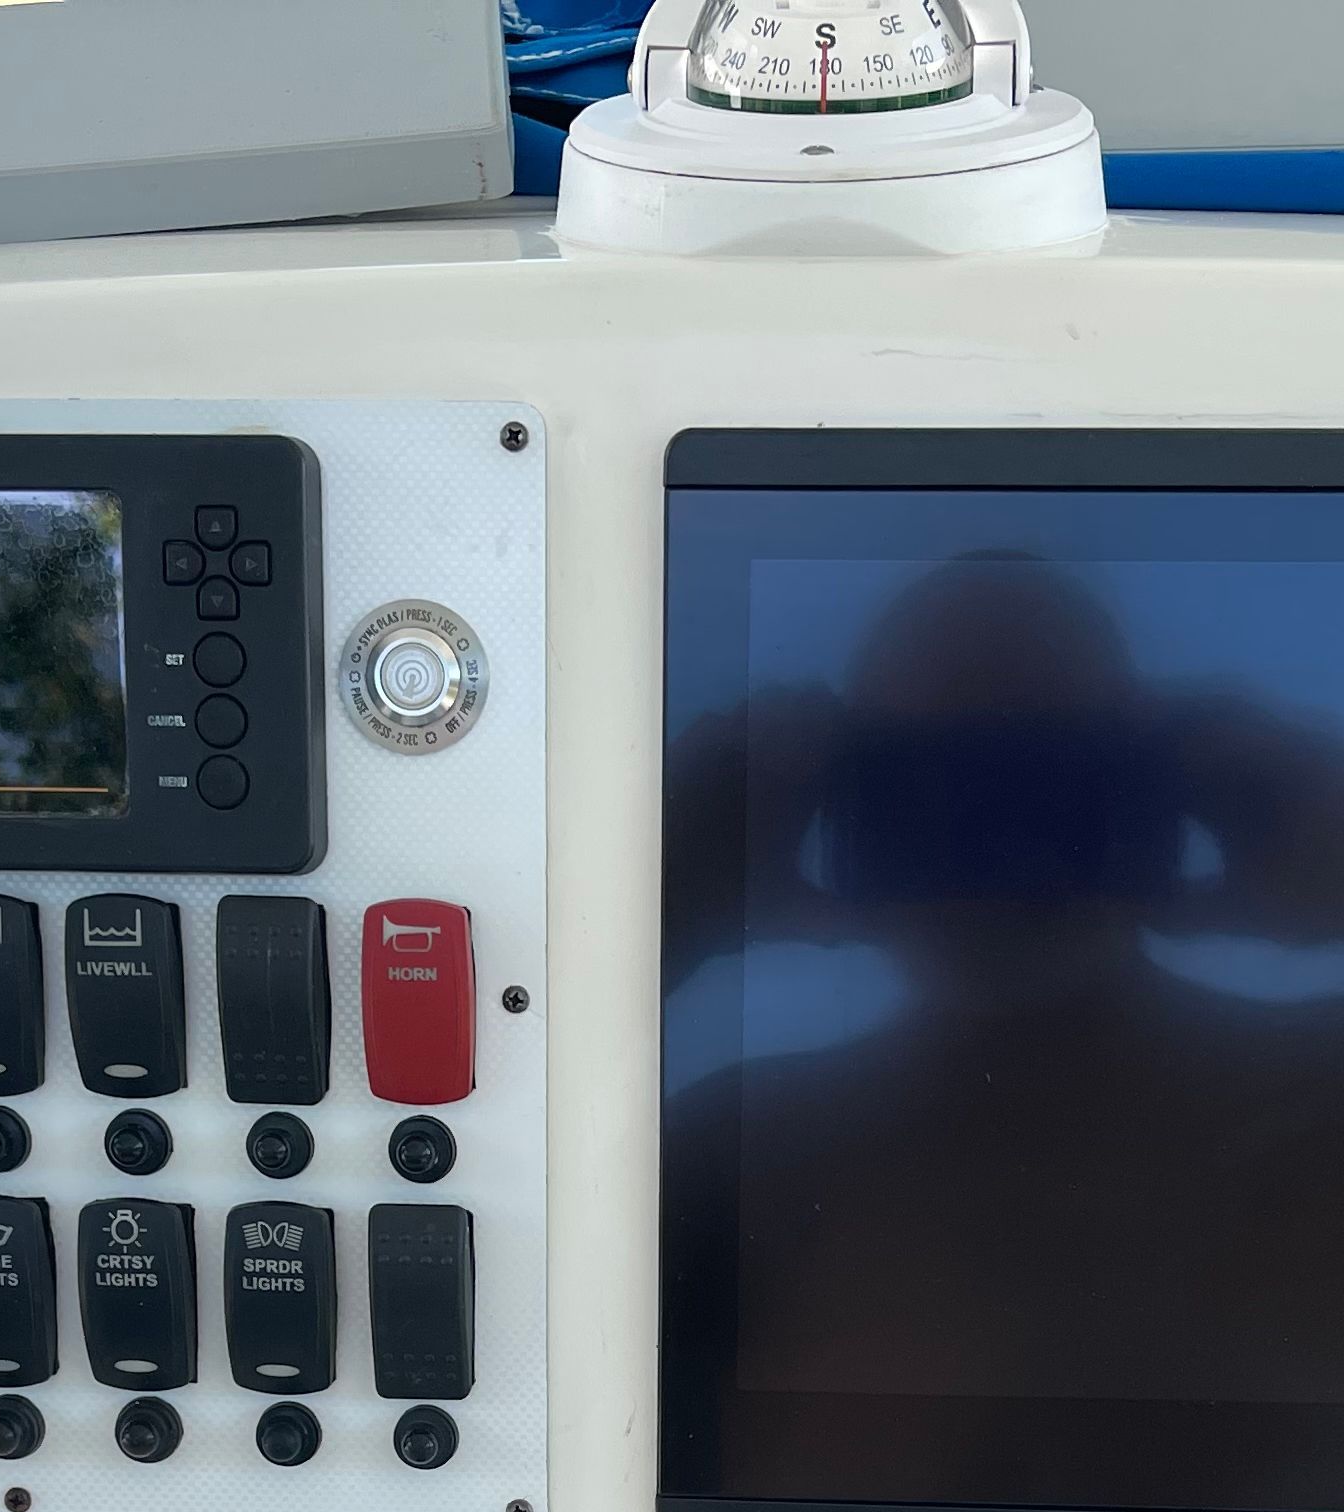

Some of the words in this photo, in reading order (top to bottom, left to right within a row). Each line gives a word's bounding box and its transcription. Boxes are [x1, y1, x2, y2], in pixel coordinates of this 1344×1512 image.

[751, 17, 783, 39] SW
[815, 23, 836, 49] S
[879, 15, 904, 36] SE
[721, 48, 746, 70] 240
[758, 58, 790, 75] 210
[863, 54, 894, 73] 150
[909, 45, 934, 66] 120
[359, 623, 379, 647] SYNC
[406, 609, 432, 623] PRESS
[441, 620, 458, 637] SEC
[165, 653, 184, 666] SET
[466, 659, 479, 676] SEC
[462, 689, 478, 716] PRESS
[147, 715, 185, 728] CANCEL
[351, 687, 368, 715] PAUSE
[368, 716, 392, 739] PRESS
[403, 734, 418, 746] SEC
[445, 717, 461, 734] OFF
[158, 775, 188, 788] MENU
[76, 961, 153, 977] LIVEWLL
[388, 967, 438, 982] HORN
[97, 1254, 155, 1271] CRTSY
[243, 1258, 304, 1275] SPRDR
[95, 1272, 158, 1288] LIGHTS
[242, 1276, 305, 1292] LIGHTS
